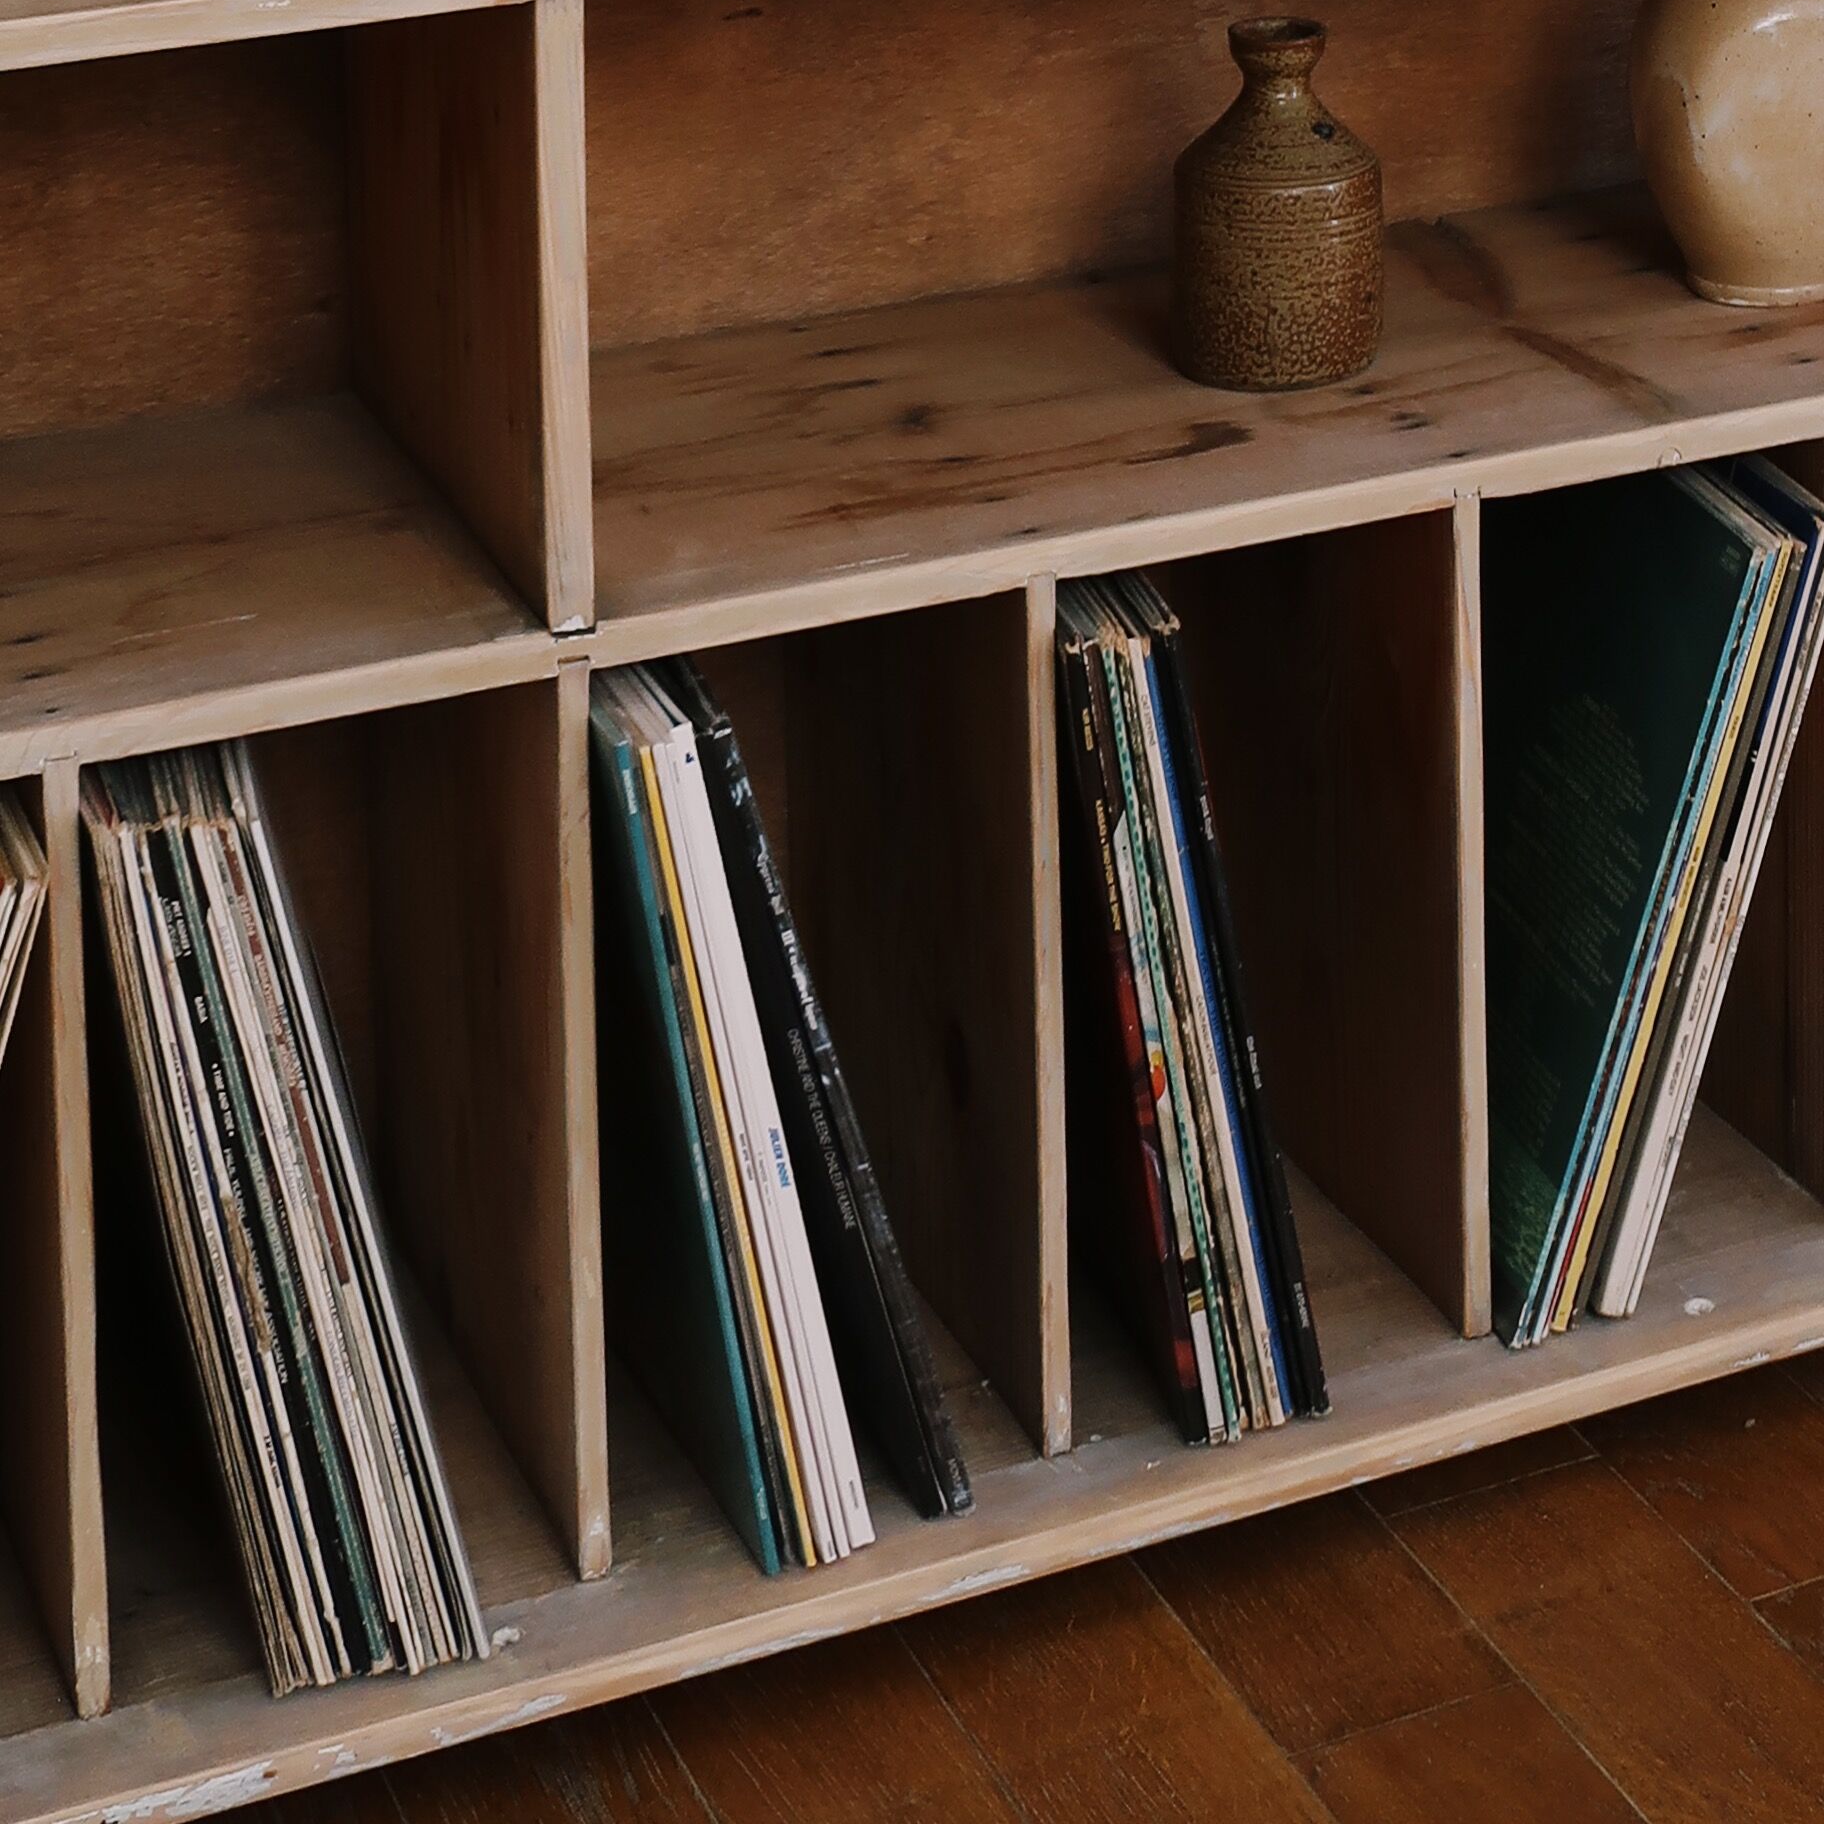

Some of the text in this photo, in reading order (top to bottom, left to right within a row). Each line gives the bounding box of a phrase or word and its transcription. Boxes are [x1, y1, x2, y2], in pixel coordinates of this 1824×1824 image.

[785, 1027, 810, 1072] CHRISTINE
[799, 1072, 816, 1092] AND
[216, 1091, 229, 1110] AND
[805, 1092, 821, 1110] THE
[765, 1126, 786, 1159] JULIEN
[809, 1109, 832, 1146] QUEENS
[822, 1150, 845, 1191] CHALEUR
[833, 1189, 857, 1230] HUMAINE
